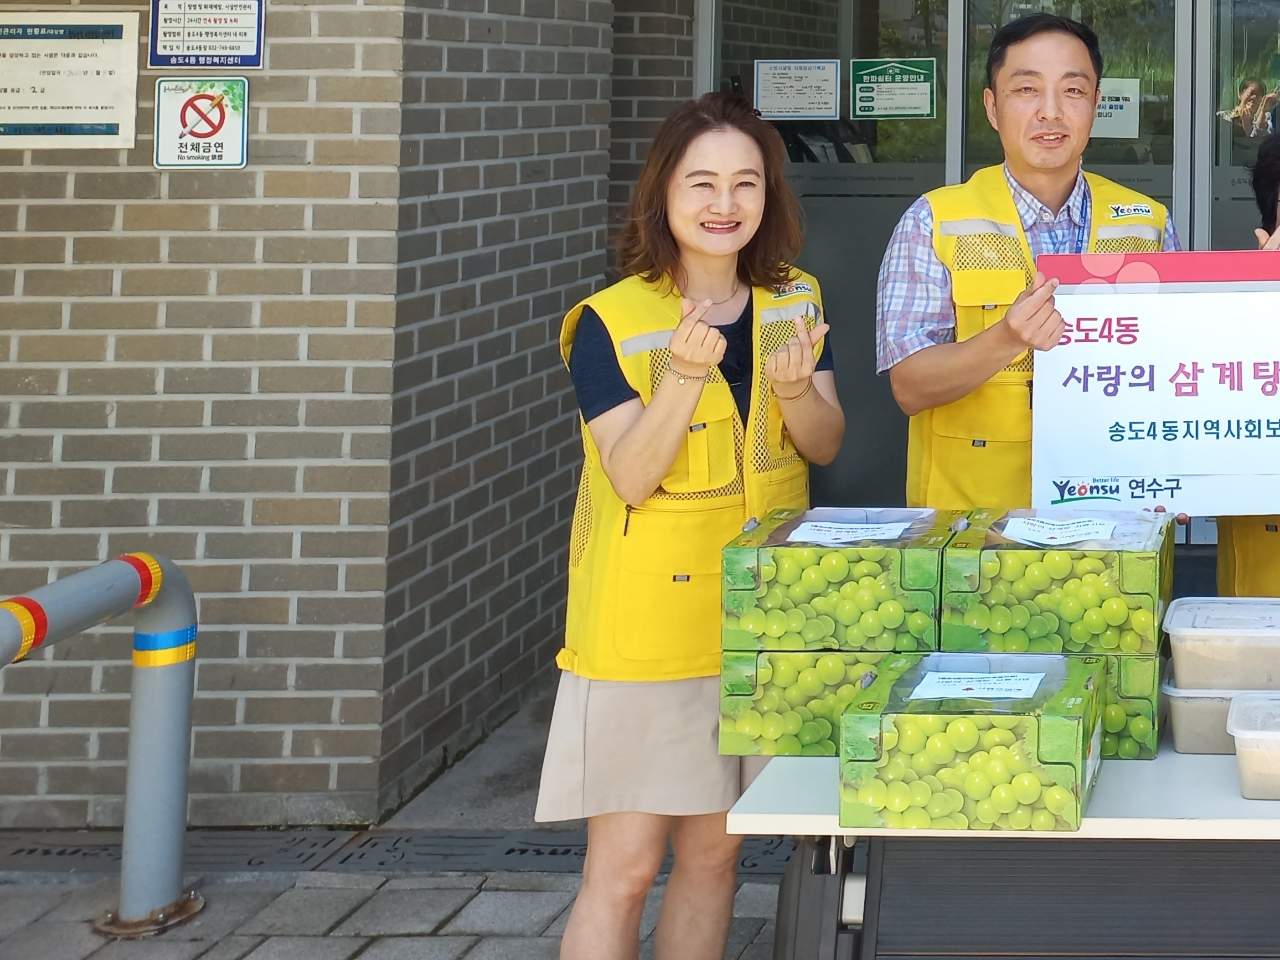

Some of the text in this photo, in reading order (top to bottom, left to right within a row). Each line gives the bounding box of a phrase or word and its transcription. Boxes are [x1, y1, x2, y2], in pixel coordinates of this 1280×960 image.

[169, 56, 241, 64] 송도4동 행정복지센터
[862, 74, 892, 82] 한파쉼터
[177, 142, 224, 153] 전체금연
[1110, 205, 1151, 217] Yeonsu
[1062, 364, 1156, 397] 사랑의
[1052, 480, 1120, 501] Yeonsu
[1128, 478, 1182, 499] 연수구
